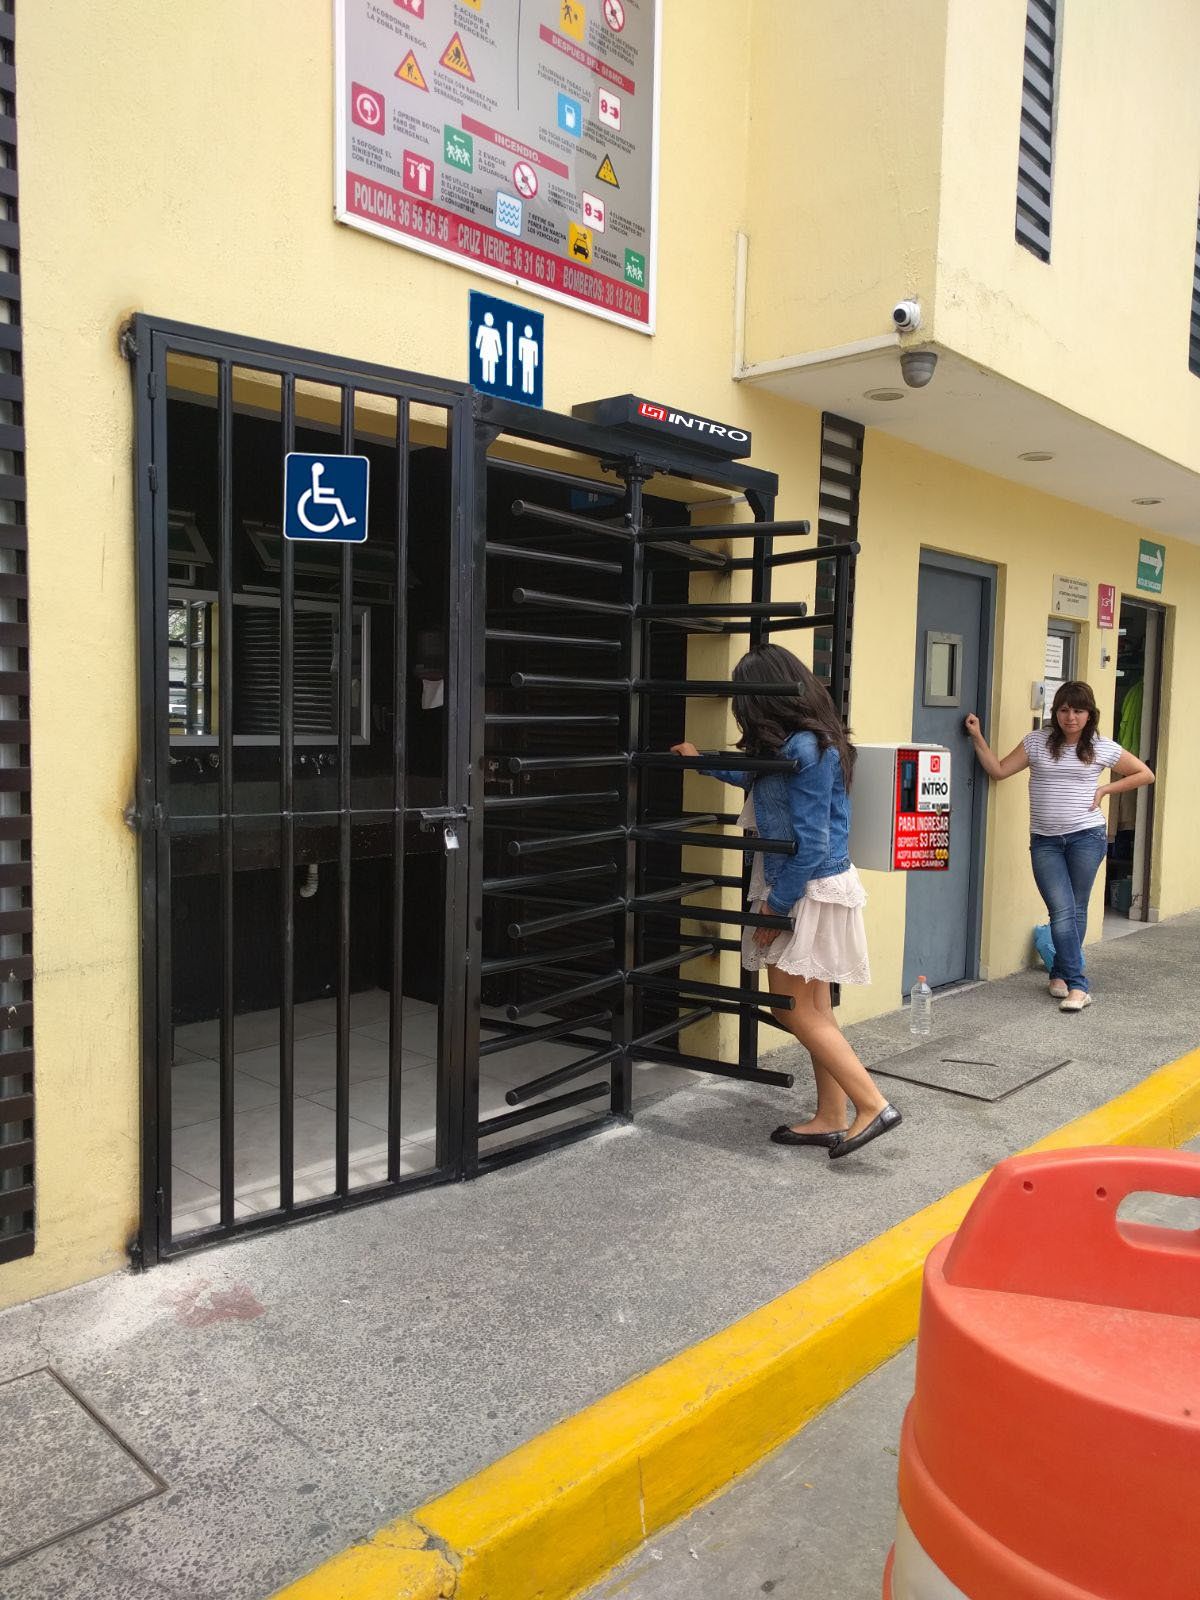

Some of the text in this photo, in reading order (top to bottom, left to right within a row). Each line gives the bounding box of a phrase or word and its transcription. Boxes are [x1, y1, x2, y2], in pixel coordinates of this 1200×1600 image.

[376, 17, 392, 31] ZONA
[454, 11, 478, 29] EQUIPO
[552, 34, 584, 62] DESPUES
[587, 55, 599, 71] DEL
[422, 121, 439, 134] BOTON
[352, 144, 381, 162] SINIESTRO
[357, 138, 383, 154] SOFOQUE
[494, 132, 540, 162] INCENDIO.
[352, 152, 363, 163] CON
[483, 151, 505, 166] EVACUE
[484, 159, 494, 169] LOS
[354, 180, 448, 242] POLICIA: 36 56 56 56
[470, 199, 478, 208] POR
[527, 226, 535, 234] LOS
[458, 222, 555, 283] CRUZ VERDE: 36 31 66 30
[563, 265, 641, 316] BOMBEROS: 38 18 22 03
[669, 413, 748, 442] INTRO
[921, 782, 948, 795] INTRO
[898, 816, 949, 831] PARA INGRESAR
[929, 832, 949, 847] PESOS
[900, 859, 945, 868] NO DA CAMBIO
